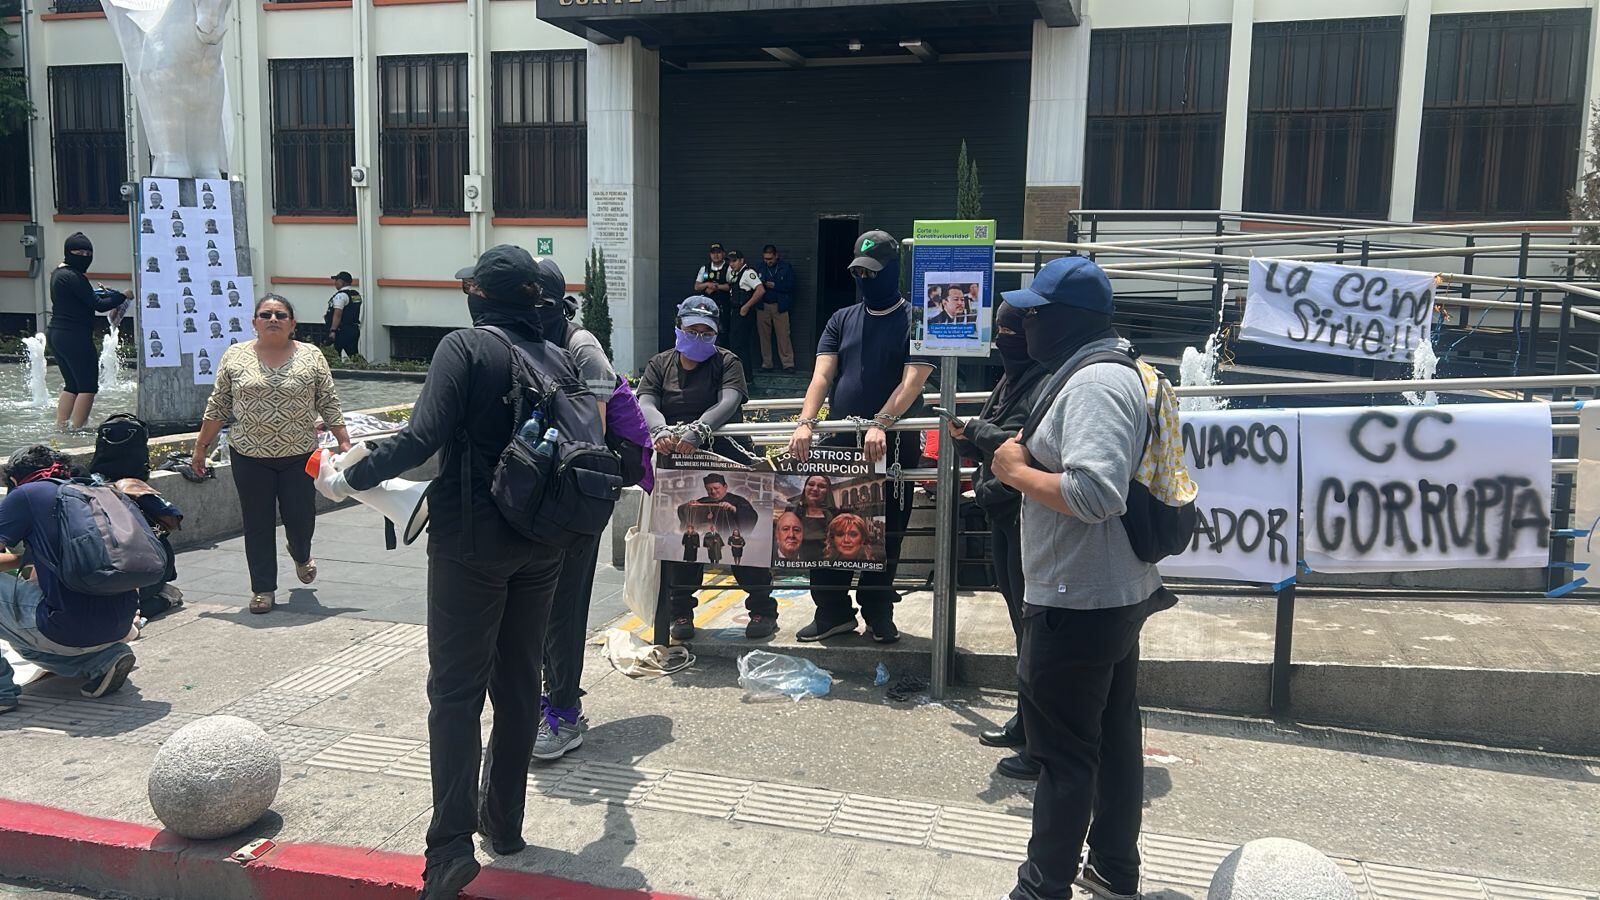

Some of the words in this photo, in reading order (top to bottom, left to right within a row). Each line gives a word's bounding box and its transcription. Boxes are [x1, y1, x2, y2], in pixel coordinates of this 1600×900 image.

[808, 450, 852, 461] OSTROS
[1182, 422, 1288, 469] NARCO
[1348, 410, 1457, 463] CC
[781, 463, 793, 471] LA
[797, 463, 869, 474] CORRUPCION
[1316, 477, 1550, 560] CORRUPTA
